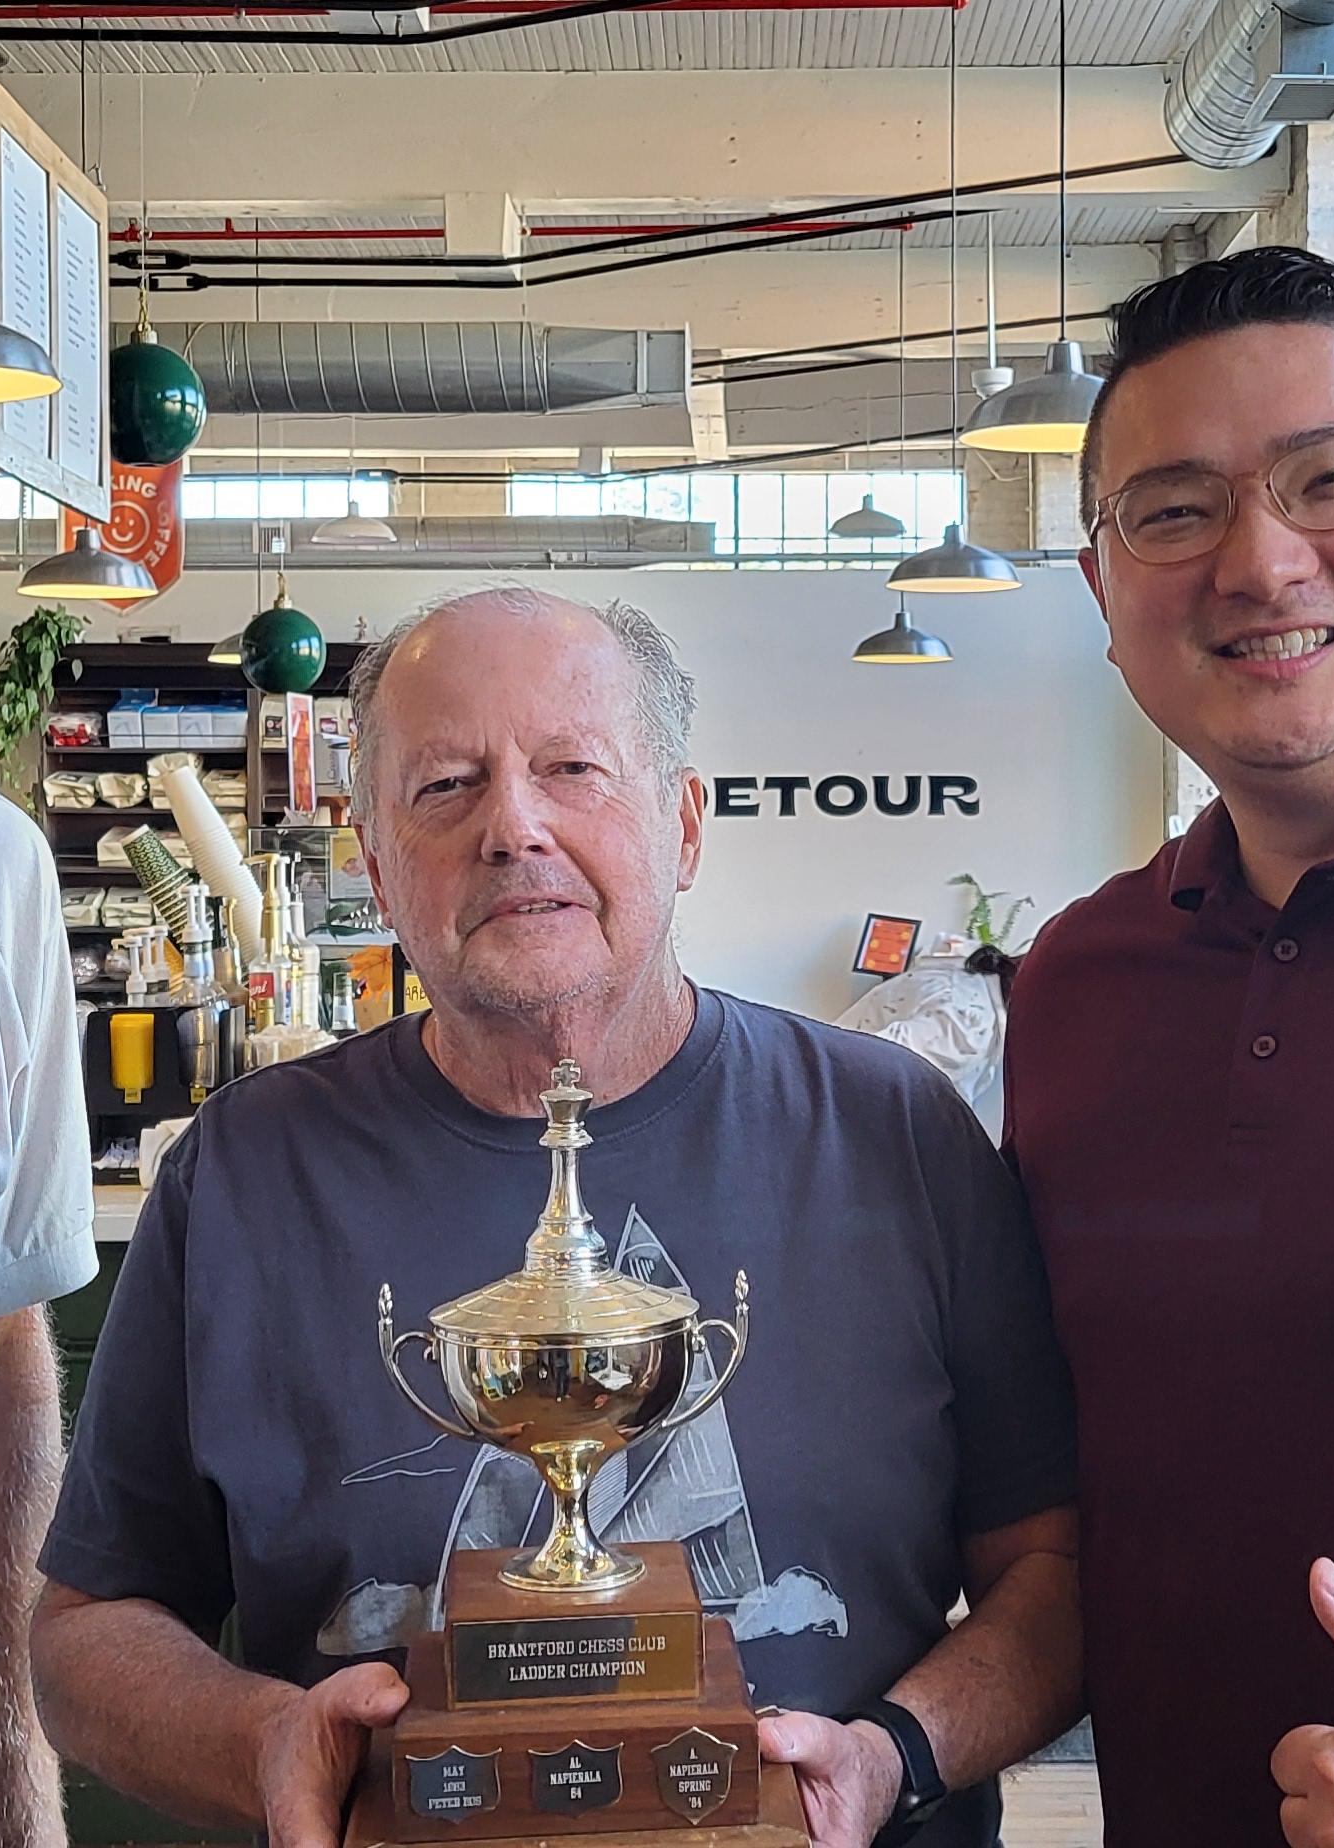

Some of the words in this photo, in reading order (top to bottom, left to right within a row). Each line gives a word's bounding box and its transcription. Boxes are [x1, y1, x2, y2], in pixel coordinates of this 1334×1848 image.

[702, 775, 980, 818] ETOUR
[487, 1640, 575, 1659] BRANTFORD
[578, 1638, 625, 1655] CHESS
[628, 1636, 666, 1652] CLUB
[509, 1664, 566, 1682] LADDER
[569, 1660, 646, 1679] CHAMPION
[569, 1756, 582, 1769] AL
[669, 1762, 719, 1778] NAPIERALA
[443, 1765, 465, 1778] MAY
[550, 1770, 602, 1785] NAPIERALA
[678, 1779, 712, 1793] SPRING
